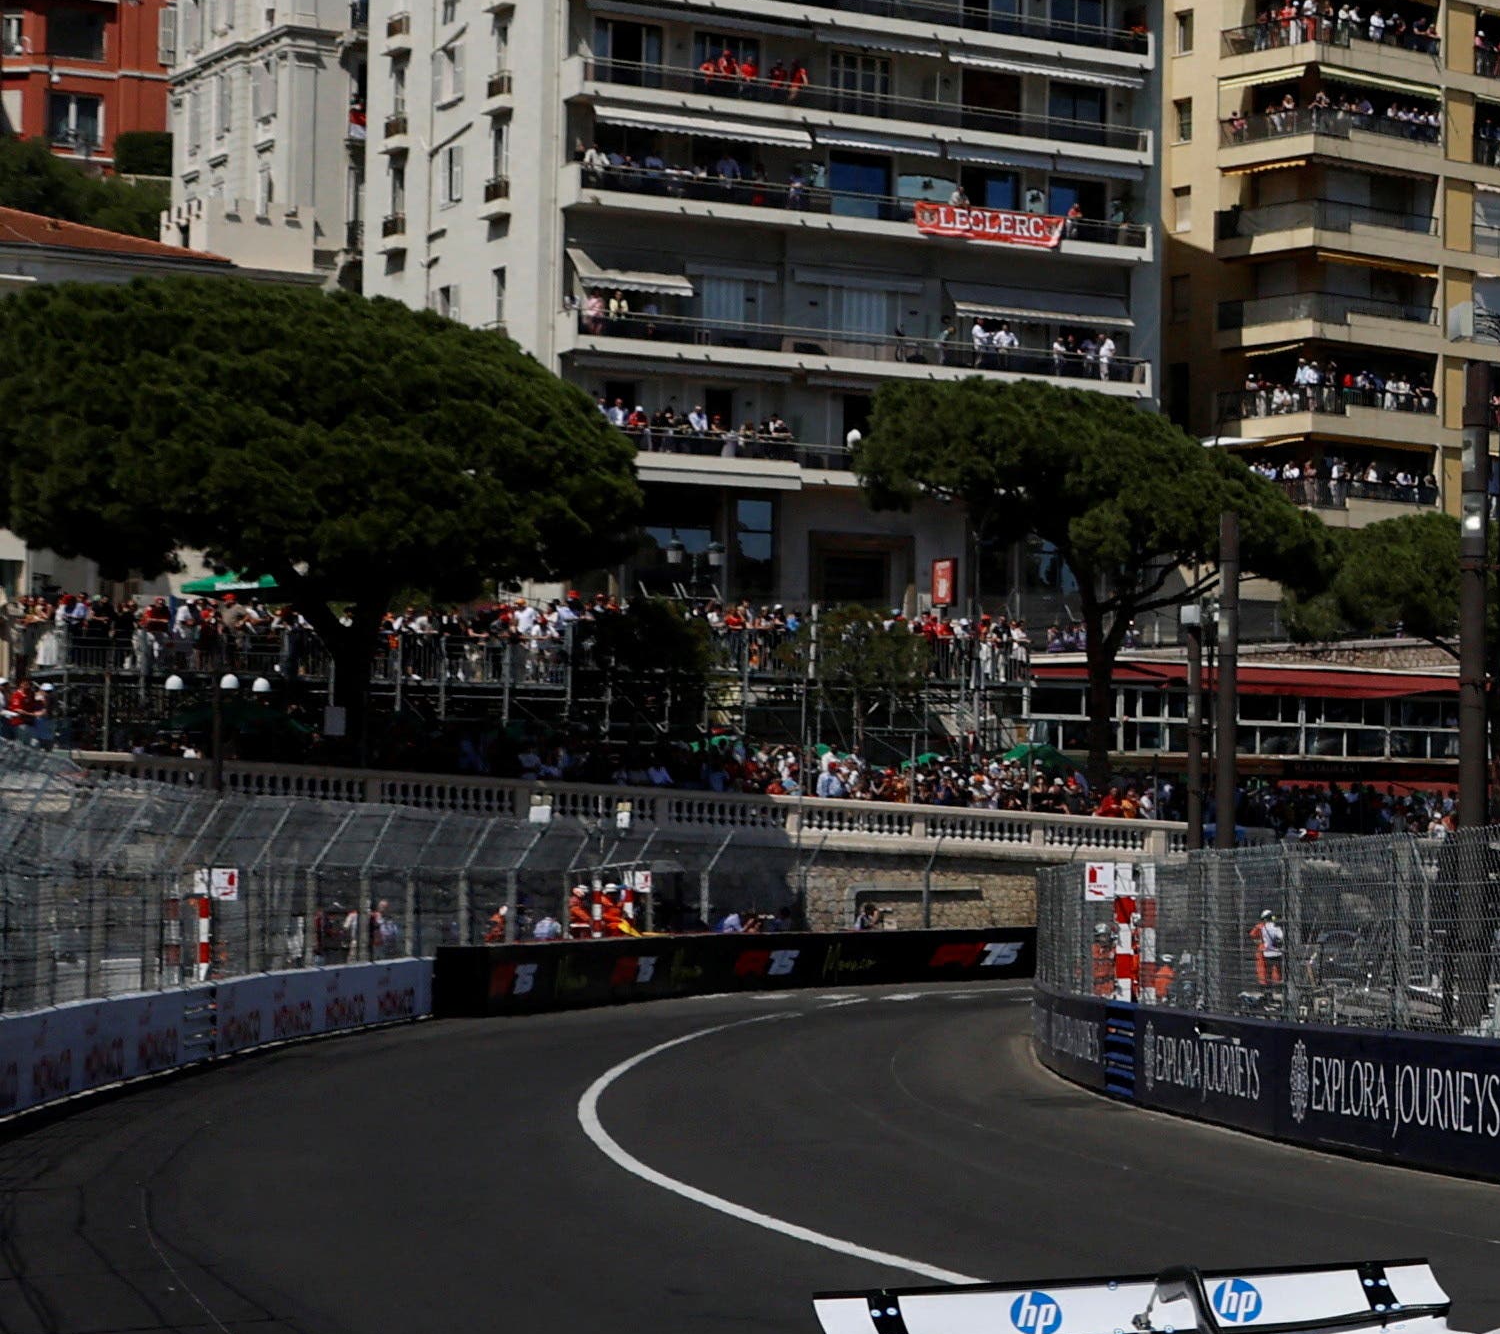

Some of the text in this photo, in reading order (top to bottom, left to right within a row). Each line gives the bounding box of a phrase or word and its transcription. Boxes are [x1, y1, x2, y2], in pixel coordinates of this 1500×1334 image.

[938, 207, 1044, 238] LECLERC
[979, 942, 1024, 966] 75
[1311, 1056, 1500, 1138] EXPLORA JOURNEYS
[1212, 1278, 1262, 1323] hp
